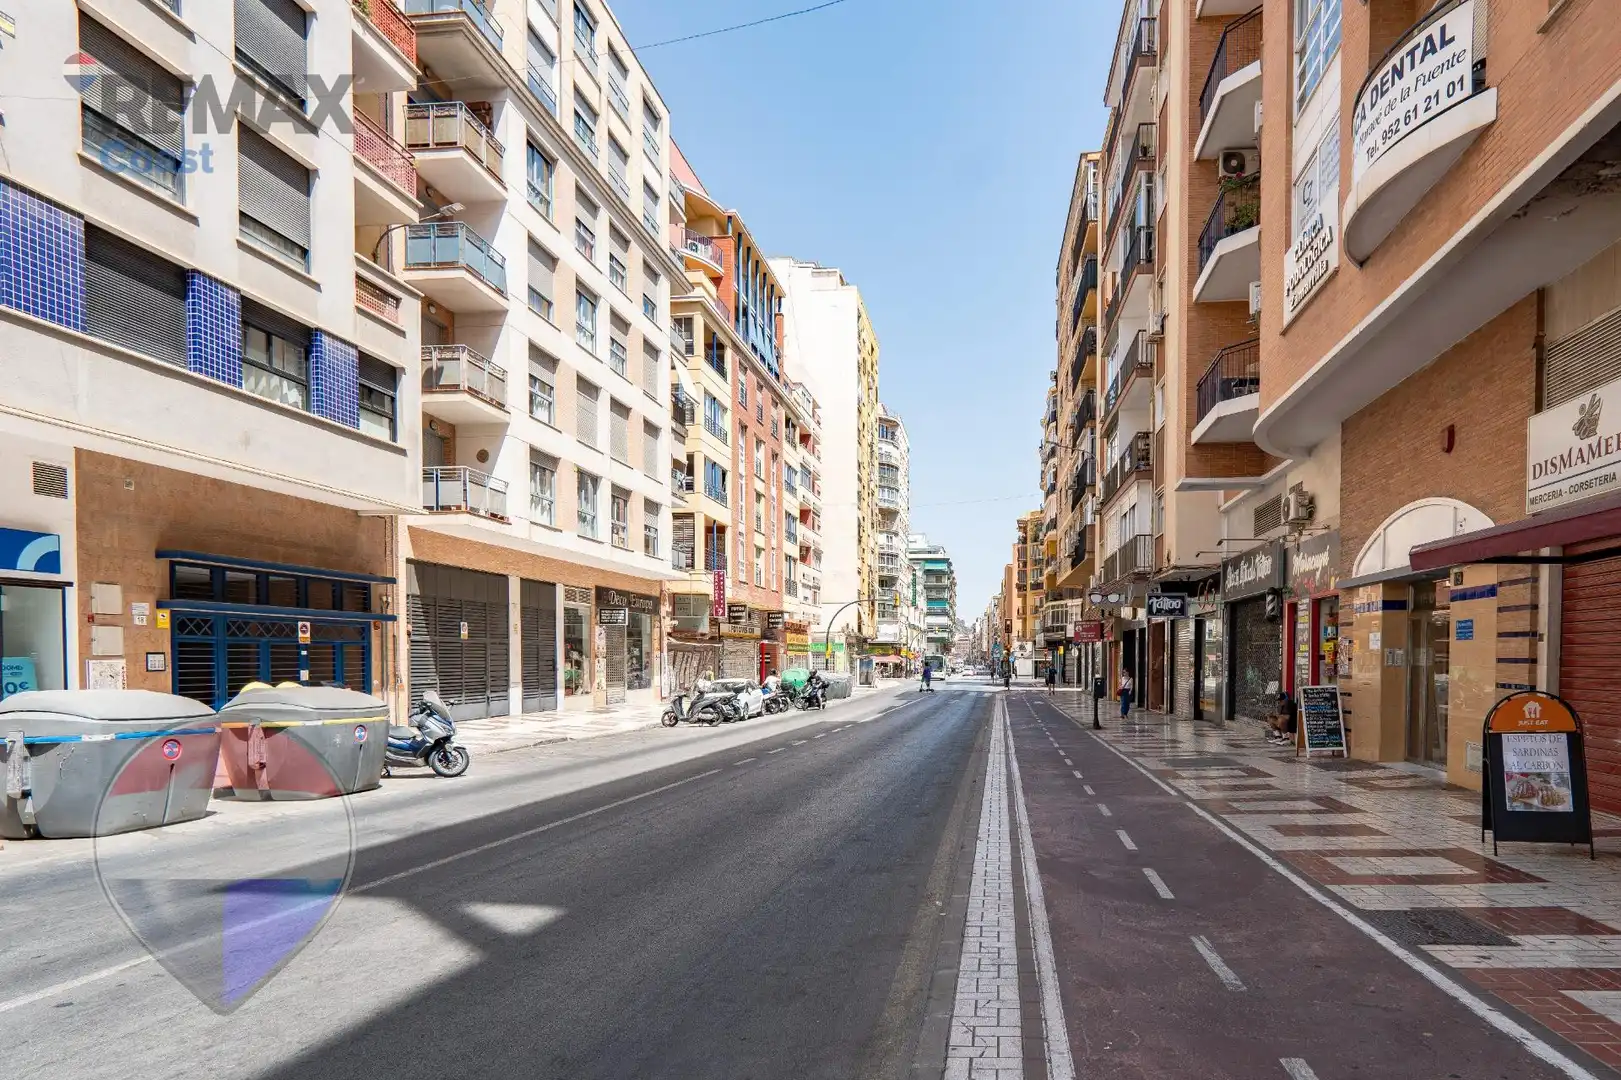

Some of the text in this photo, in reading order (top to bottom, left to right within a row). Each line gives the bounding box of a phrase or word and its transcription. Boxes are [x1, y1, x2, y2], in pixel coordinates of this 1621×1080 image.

[1370, 23, 1456, 112] DENTAL
[1384, 97, 1397, 118] de
[1400, 86, 1411, 104] la
[1414, 48, 1467, 92] Fuente
[1366, 139, 1380, 162] Tel.
[1382, 117, 1401, 146] 952
[1403, 104, 1418, 127] 61
[1424, 88, 1440, 114] 21
[1446, 73, 1464, 99] 01
[1529, 490, 1564, 507] MERCERIA
[1568, 471, 1617, 495] CORSETERIA
[1506, 734, 1563, 743] ESPETOS DE
[1512, 747, 1560, 757] SARDINAS
